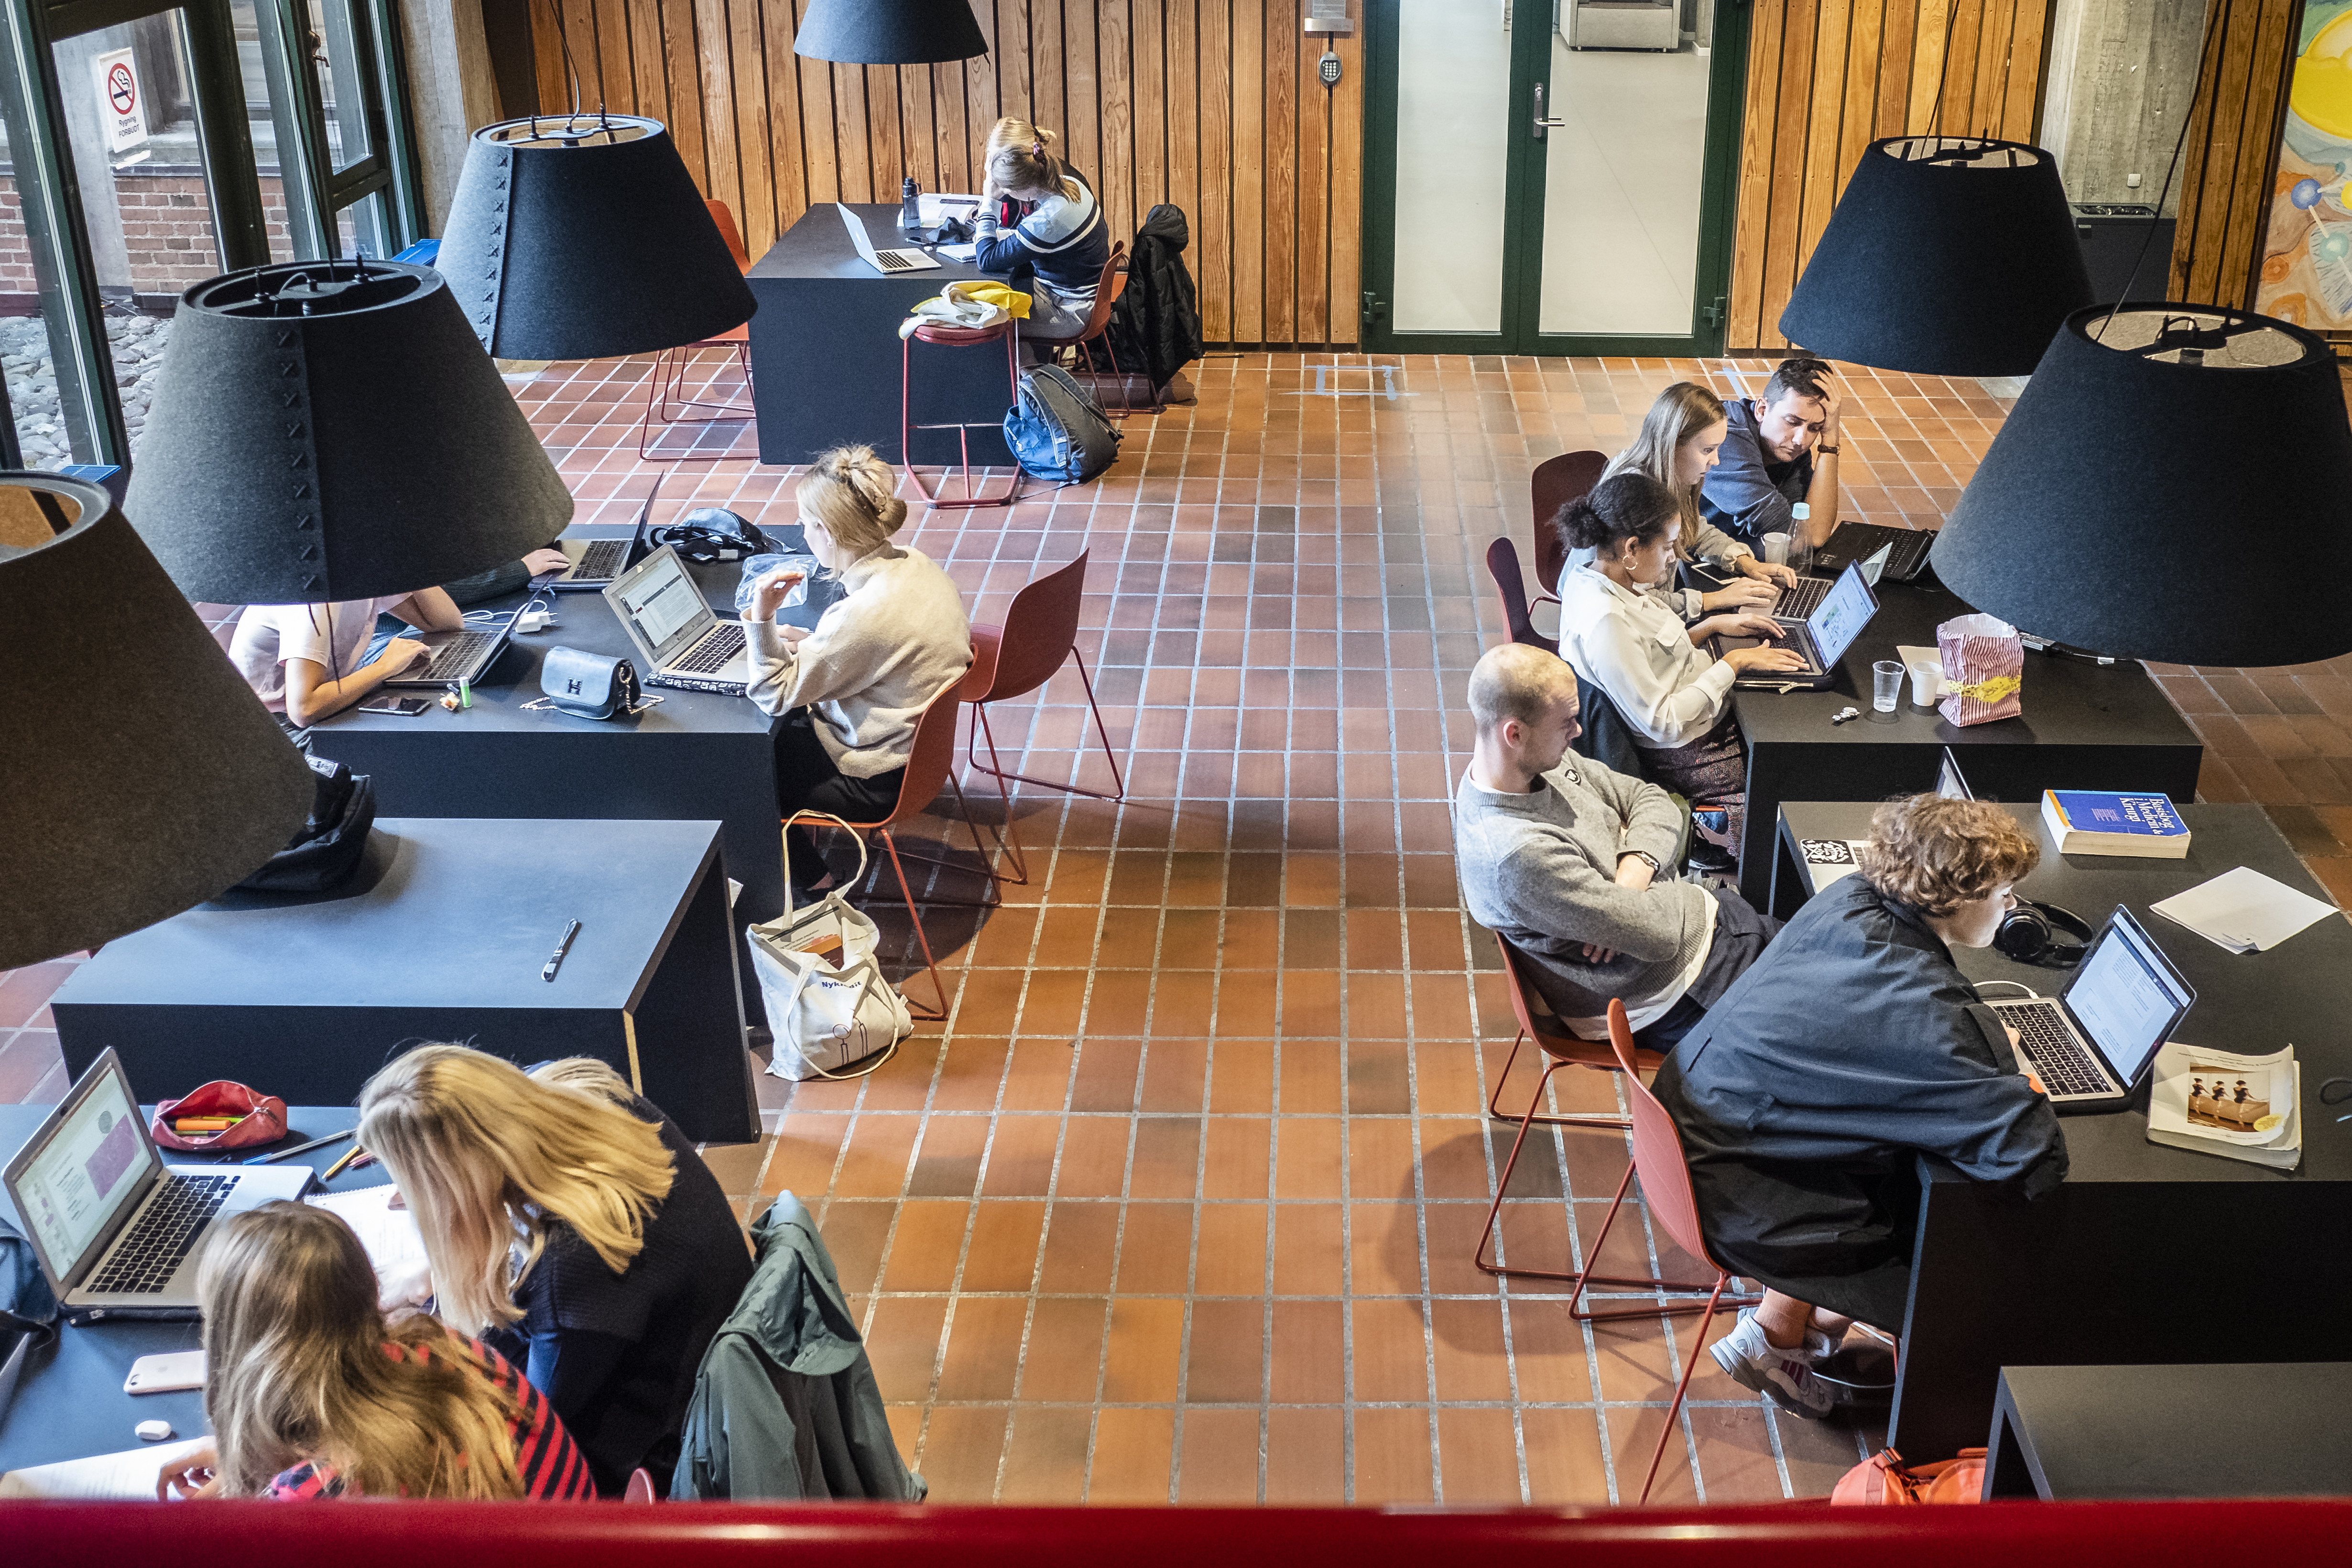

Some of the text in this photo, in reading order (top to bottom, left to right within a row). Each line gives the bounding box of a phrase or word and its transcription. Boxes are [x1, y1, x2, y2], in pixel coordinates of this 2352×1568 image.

[119, 116, 137, 127] Rygning
[119, 124, 139, 138] FORBUDT
[2119, 797, 2145, 822] Kirurgi
[2136, 801, 2160, 828] Medicin
[2149, 798, 2175, 828] Basisbog
